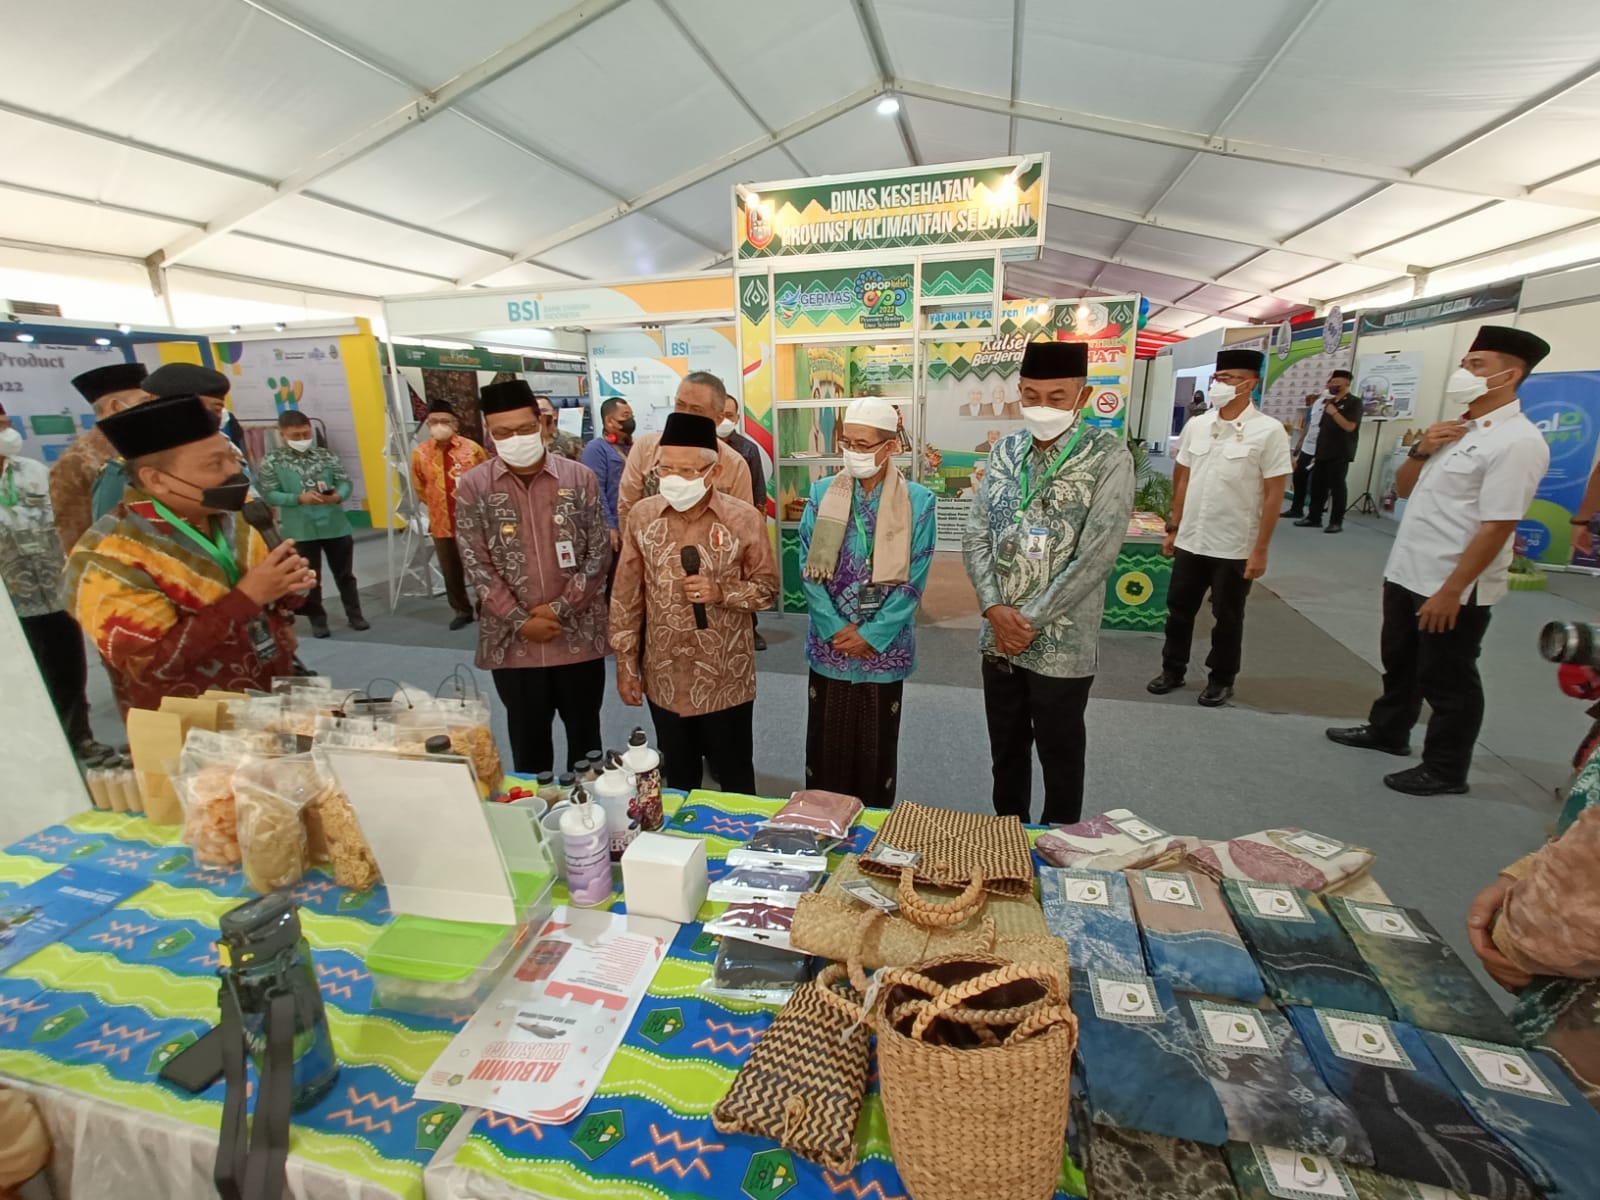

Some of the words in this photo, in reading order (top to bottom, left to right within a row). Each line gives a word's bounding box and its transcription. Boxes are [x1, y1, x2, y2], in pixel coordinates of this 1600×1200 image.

[831, 187, 877, 213] DINAS
[880, 176, 975, 208] KESEHATAN
[781, 220, 849, 247] PROVINSI
[852, 211, 953, 241] KALIMANTAN
[957, 204, 1031, 231] SELATAN
[864, 281, 891, 291] OPOP
[800, 291, 851, 305] GERMAS
[507, 299, 540, 322] BSI
[879, 305, 895, 314] 2022
[671, 342, 689, 356] BSI
[981, 333, 1031, 351] Kalsel
[612, 371, 635, 385] BSI
[469, 1059, 561, 1083] ALBUMIN
